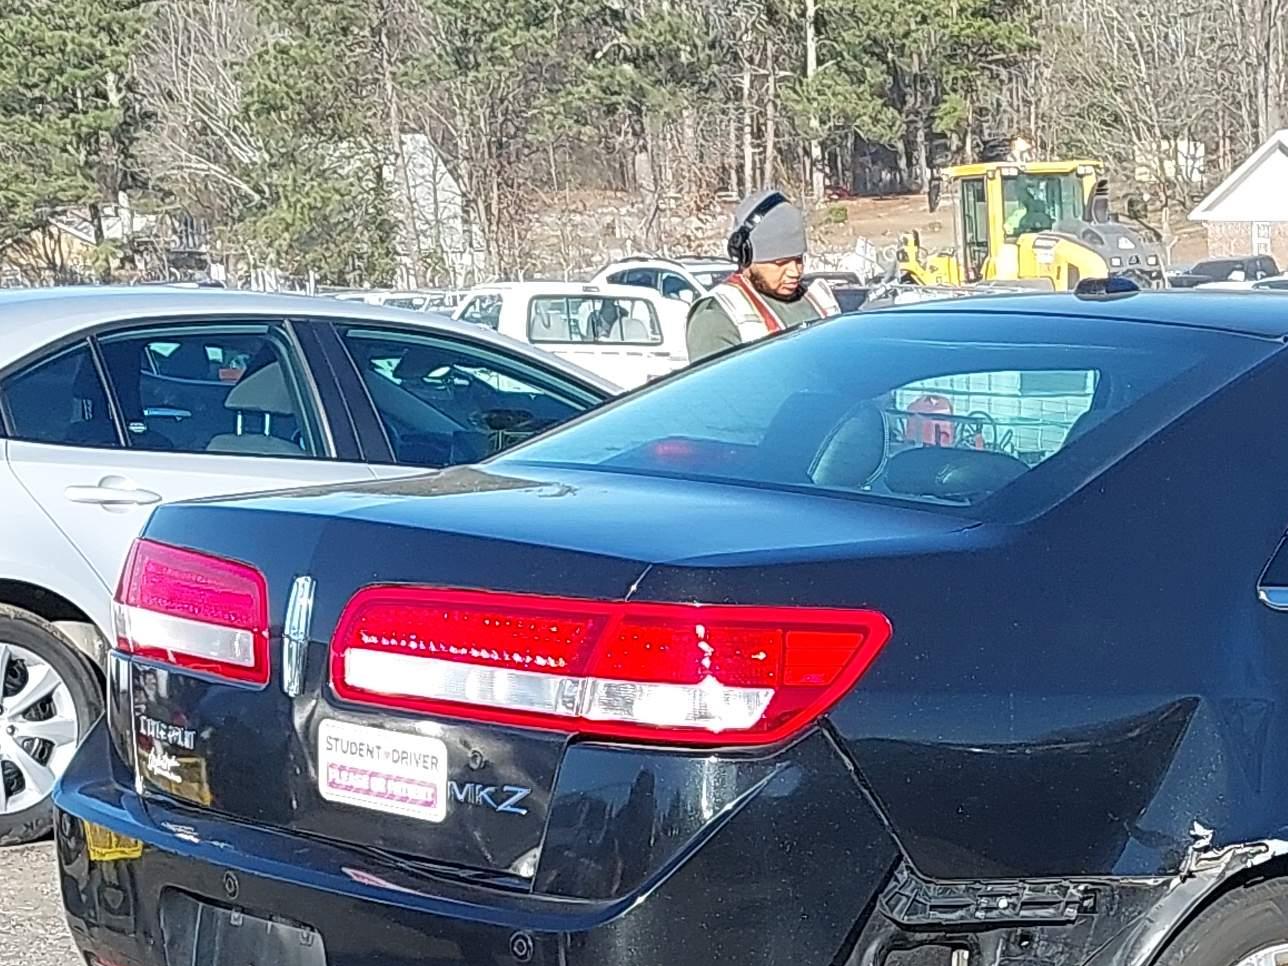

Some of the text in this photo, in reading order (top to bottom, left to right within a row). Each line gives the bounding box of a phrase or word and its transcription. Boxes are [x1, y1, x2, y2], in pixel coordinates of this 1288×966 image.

[326, 735, 439, 771] STUDENT DRIVER
[448, 780, 531, 816] MKZ
